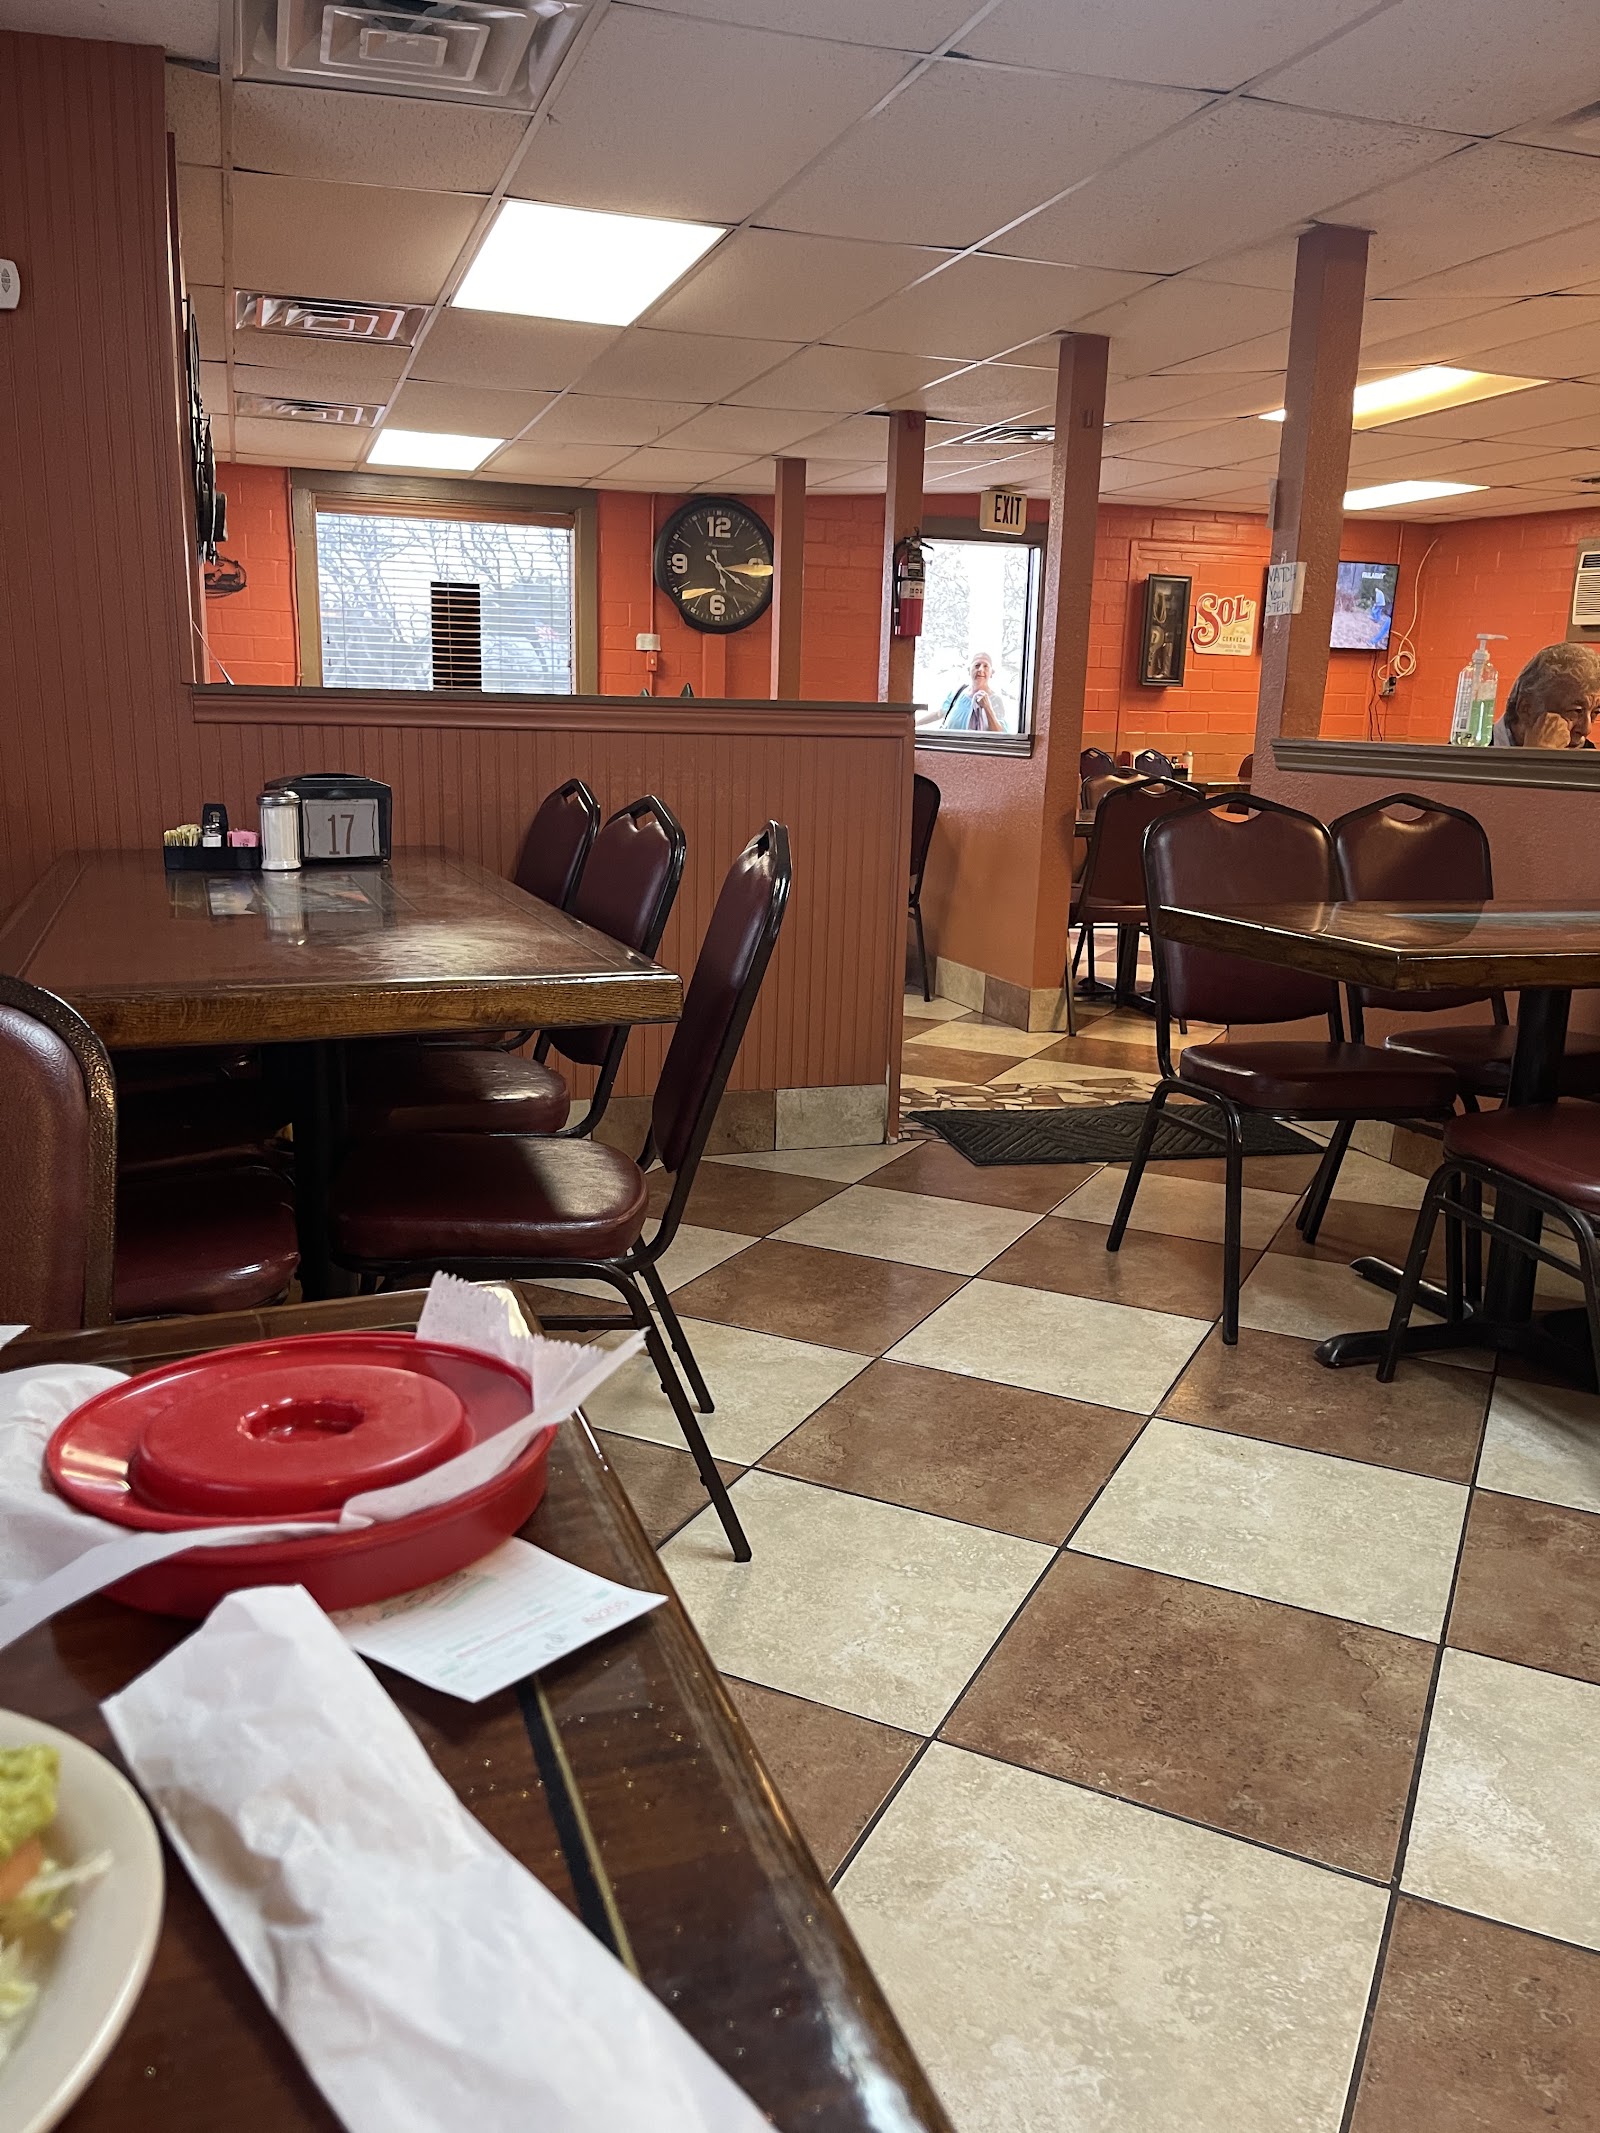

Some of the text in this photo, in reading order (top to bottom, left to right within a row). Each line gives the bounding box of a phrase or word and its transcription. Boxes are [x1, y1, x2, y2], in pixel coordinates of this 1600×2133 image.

[994, 494, 1022, 525] EXIT
[707, 516, 731, 538] 12
[671, 553, 688, 574] 9
[709, 594, 725, 615] 6
[327, 814, 354, 855] 17
